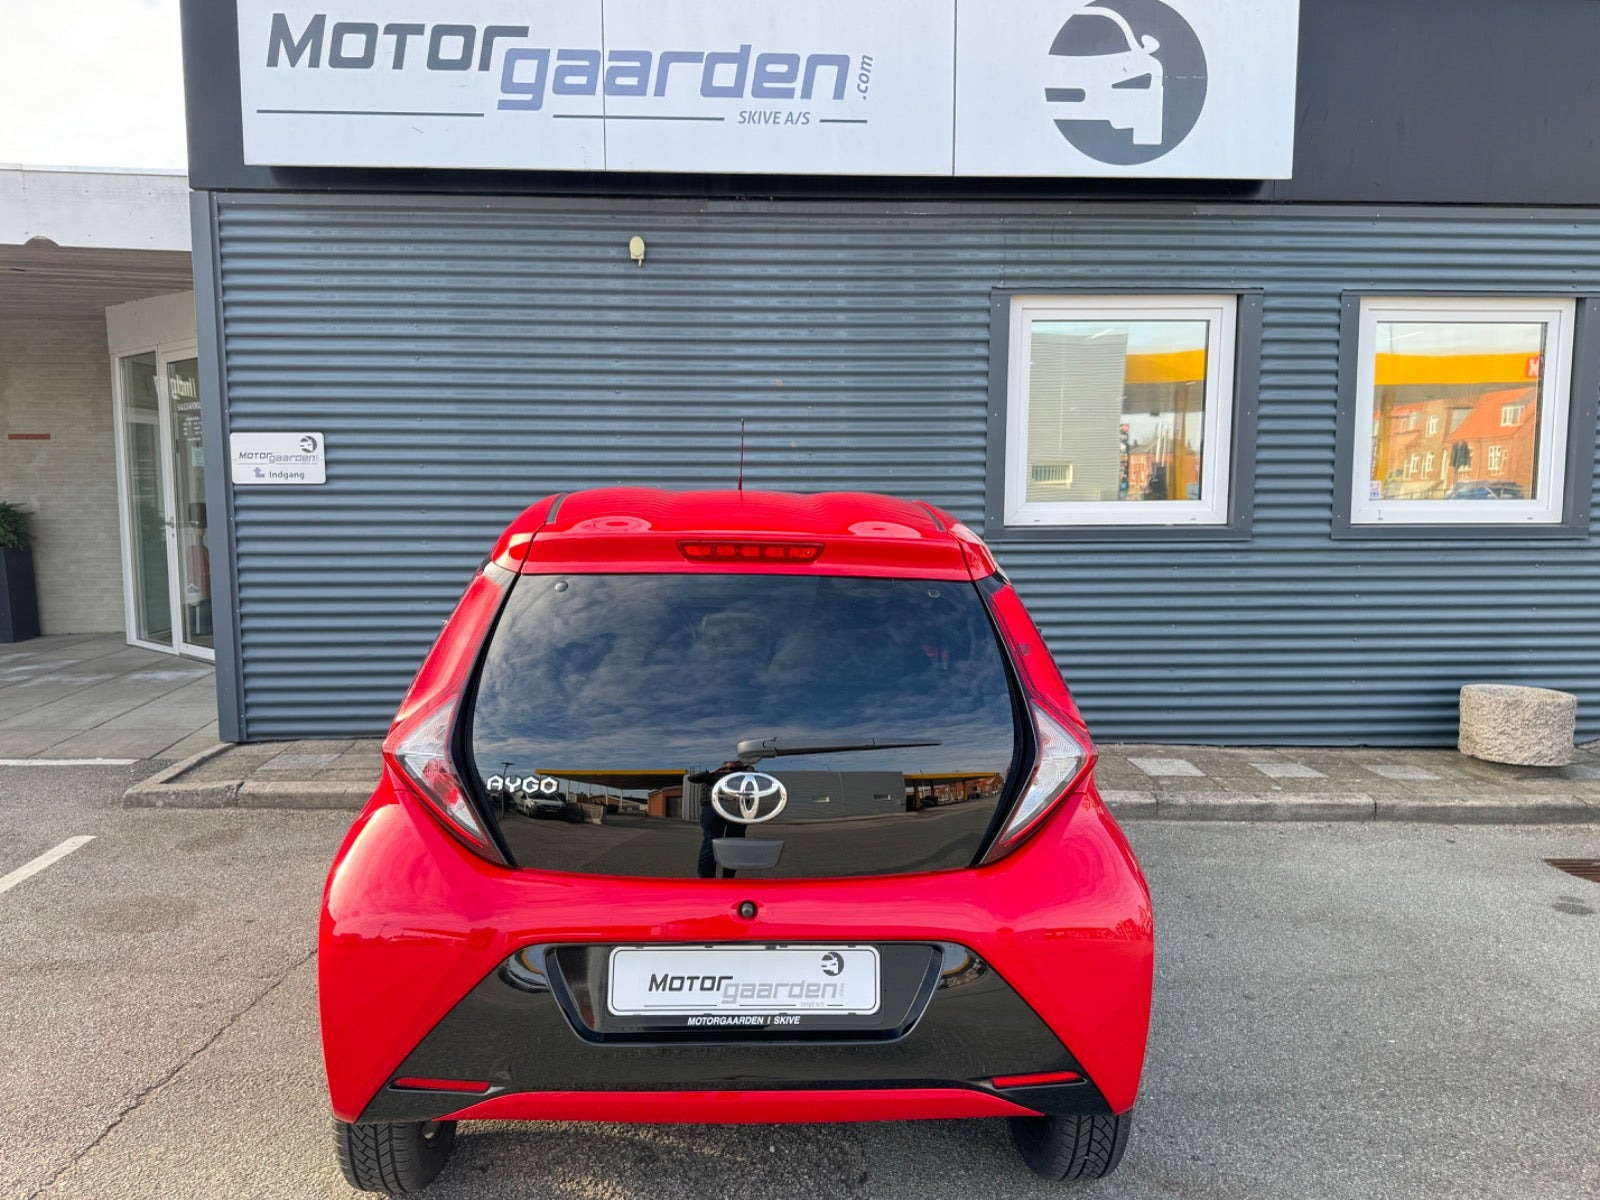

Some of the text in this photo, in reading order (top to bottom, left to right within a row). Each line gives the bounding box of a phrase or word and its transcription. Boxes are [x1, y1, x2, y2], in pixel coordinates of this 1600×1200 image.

[738, 110, 811, 125] SKIVE A/S
[269, 470, 305, 479] Indgang
[486, 774, 559, 794] AYGO
[687, 1015, 764, 1026] MOTORGAARDEN
[773, 1015, 800, 1025] SKIVE
